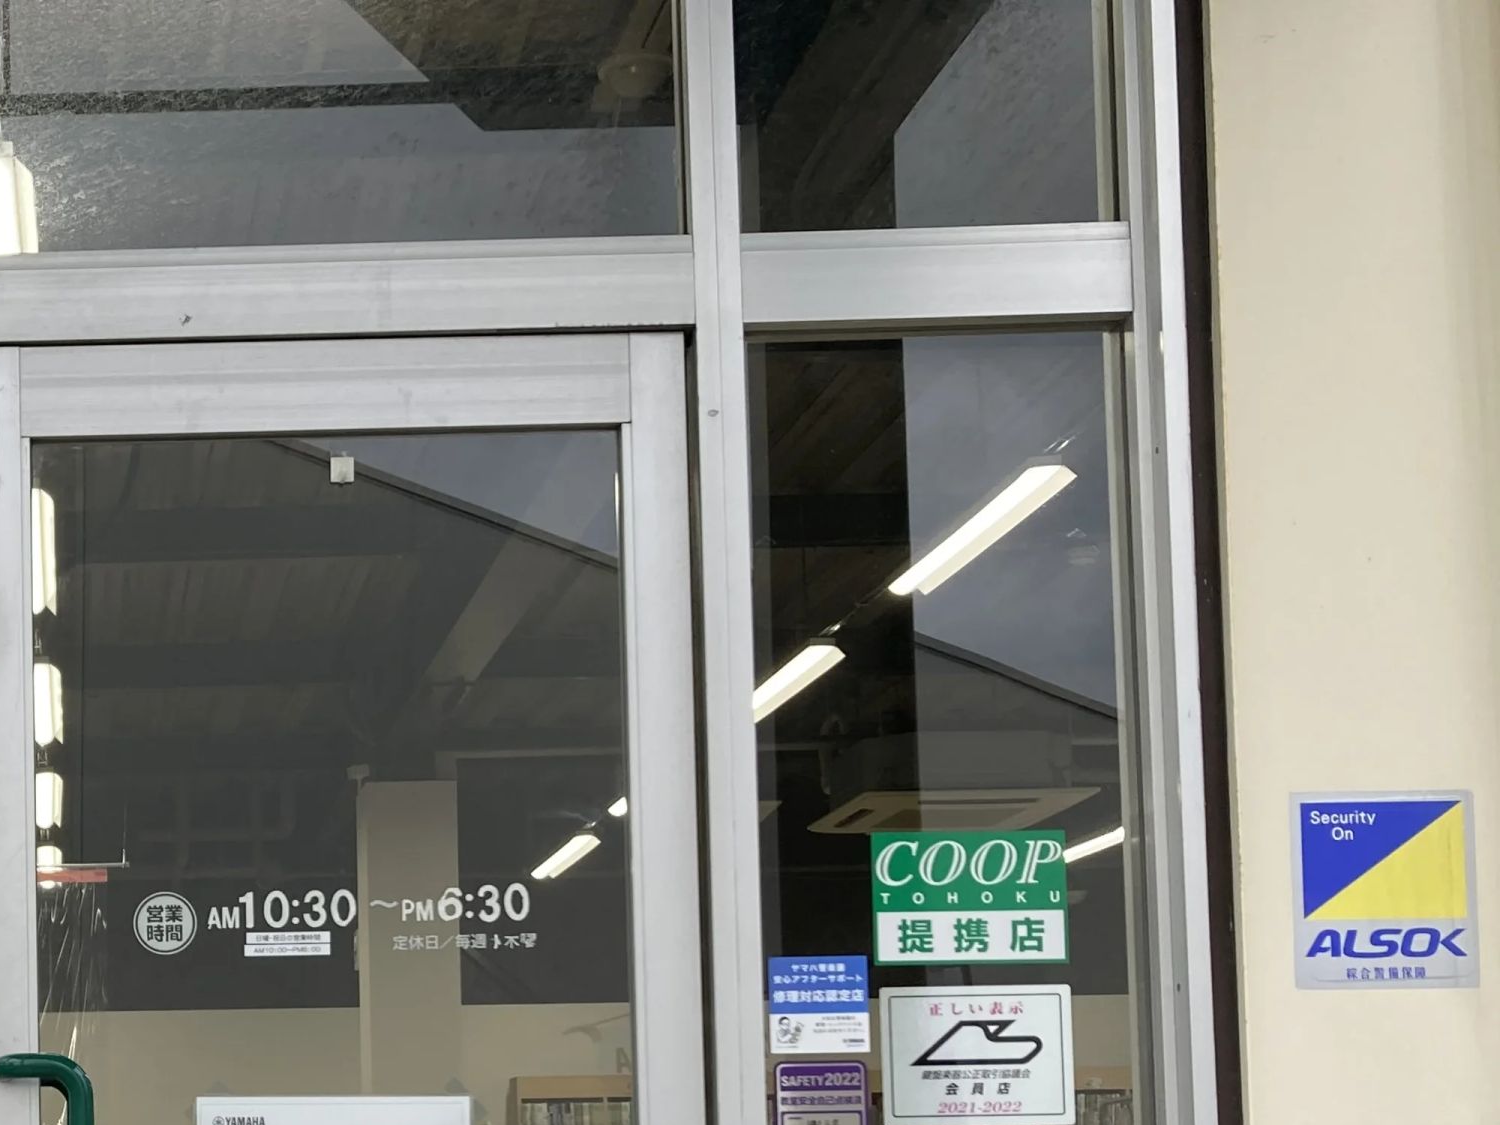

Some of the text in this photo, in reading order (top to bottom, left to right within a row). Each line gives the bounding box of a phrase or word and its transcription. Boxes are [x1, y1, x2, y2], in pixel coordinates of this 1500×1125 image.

[1310, 811, 1376, 826] Security
[1331, 827, 1354, 841] On
[874, 839, 1062, 887] COOP
[880, 891, 1061, 905] TOHOKU
[146, 904, 184, 923] 営業
[146, 924, 184, 943] 時間
[897, 917, 1046, 954] 提携店
[1305, 927, 1468, 959] ALSOK
[772, 974, 864, 984] 安心アフターサポート
[773, 989, 865, 1004] 修理対応認定店
[928, 1000, 1025, 1017] 正しい表示
[921, 1067, 1032, 1080] 鍵盤楽器公正取引協議会
[945, 1082, 1012, 1096] 会員店
[937, 1100, 1024, 1114] 2021-2022
